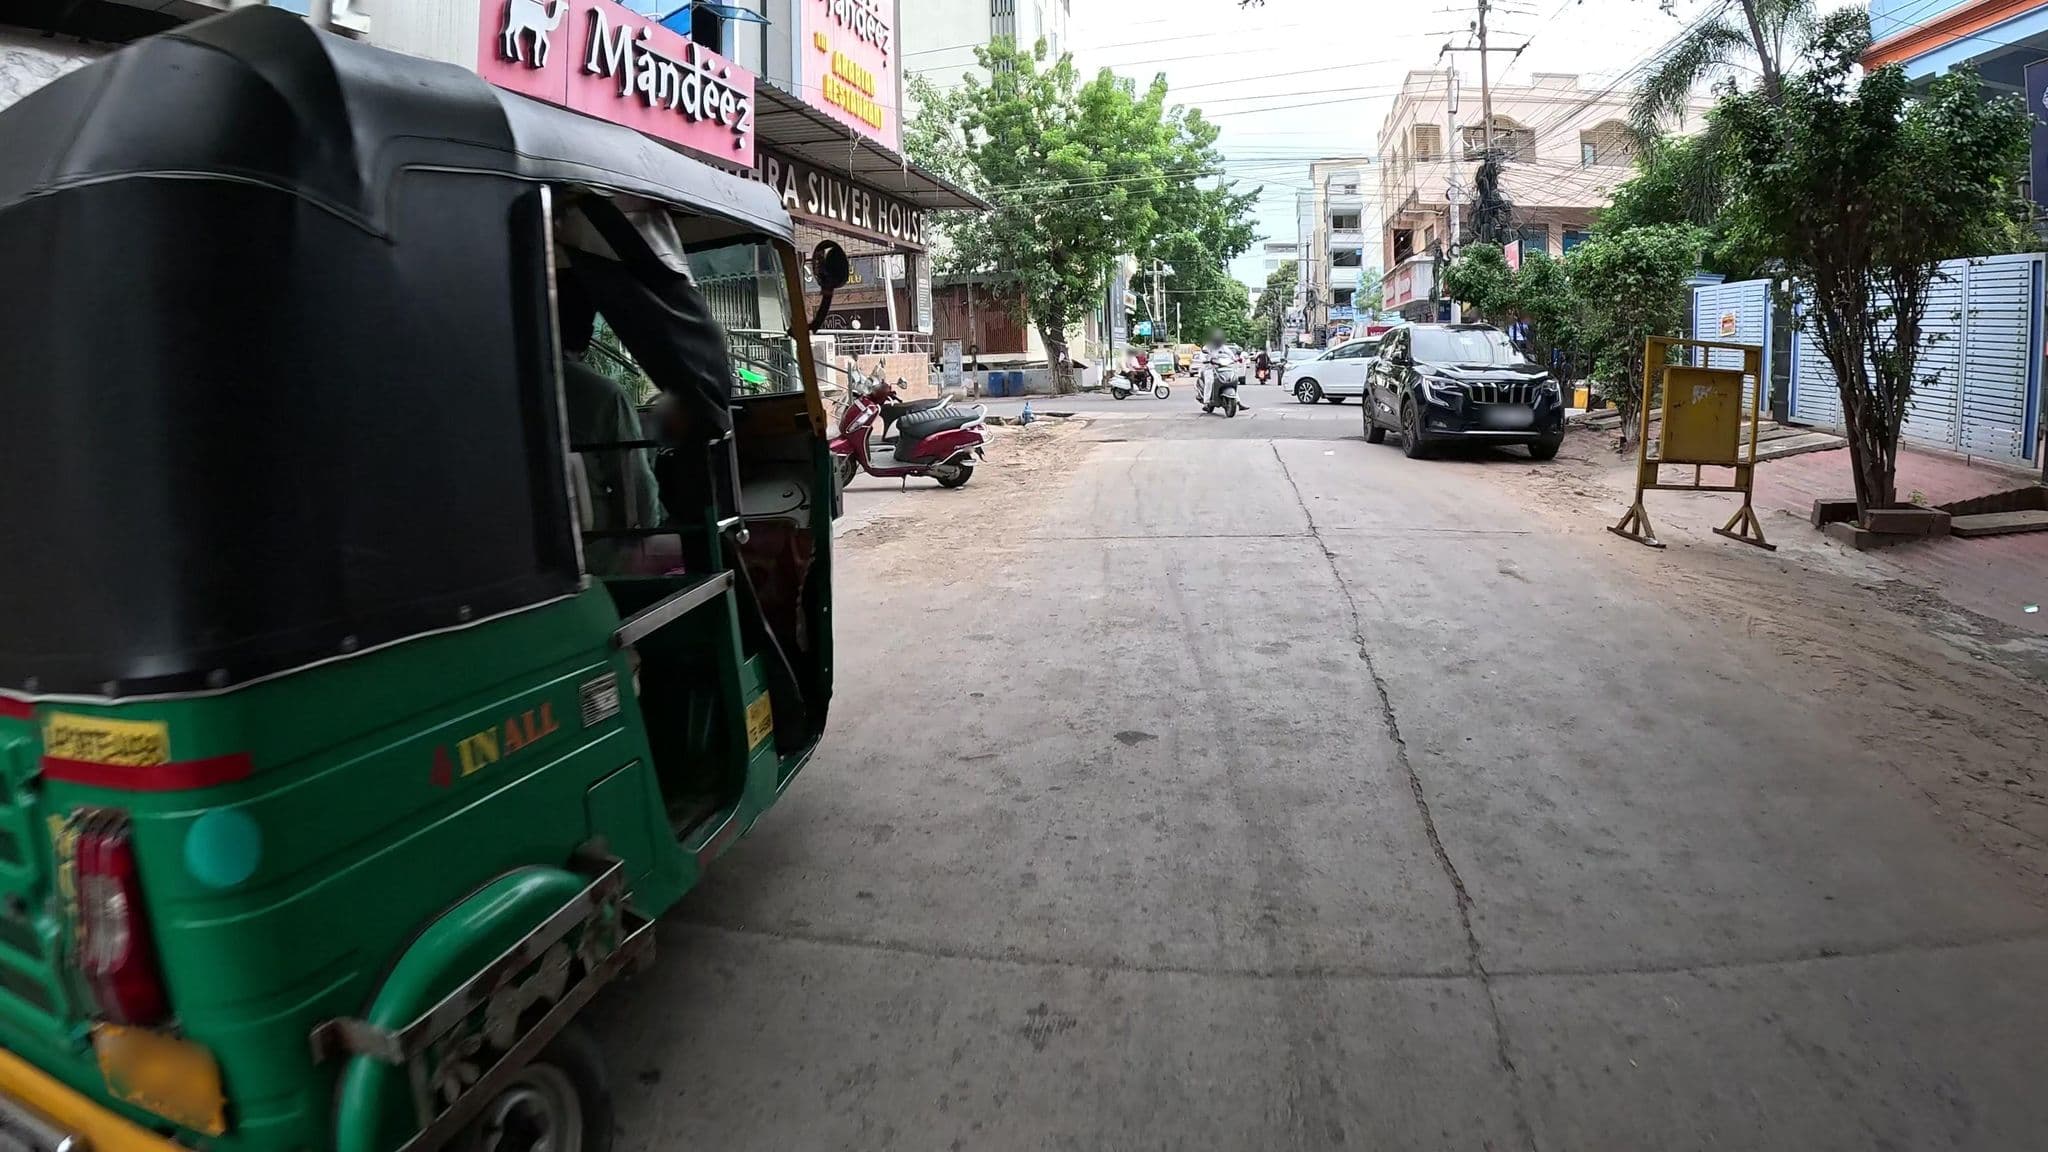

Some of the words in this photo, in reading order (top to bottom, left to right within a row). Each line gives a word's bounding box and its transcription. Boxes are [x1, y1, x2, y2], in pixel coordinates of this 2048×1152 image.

[818, 0, 891, 58] andeez
[586, 5, 753, 130] Mandeez
[808, 171, 873, 229] SILVER
[878, 197, 928, 246] HOUSE
[456, 721, 501, 777] IN
[504, 701, 560, 758] ALL
